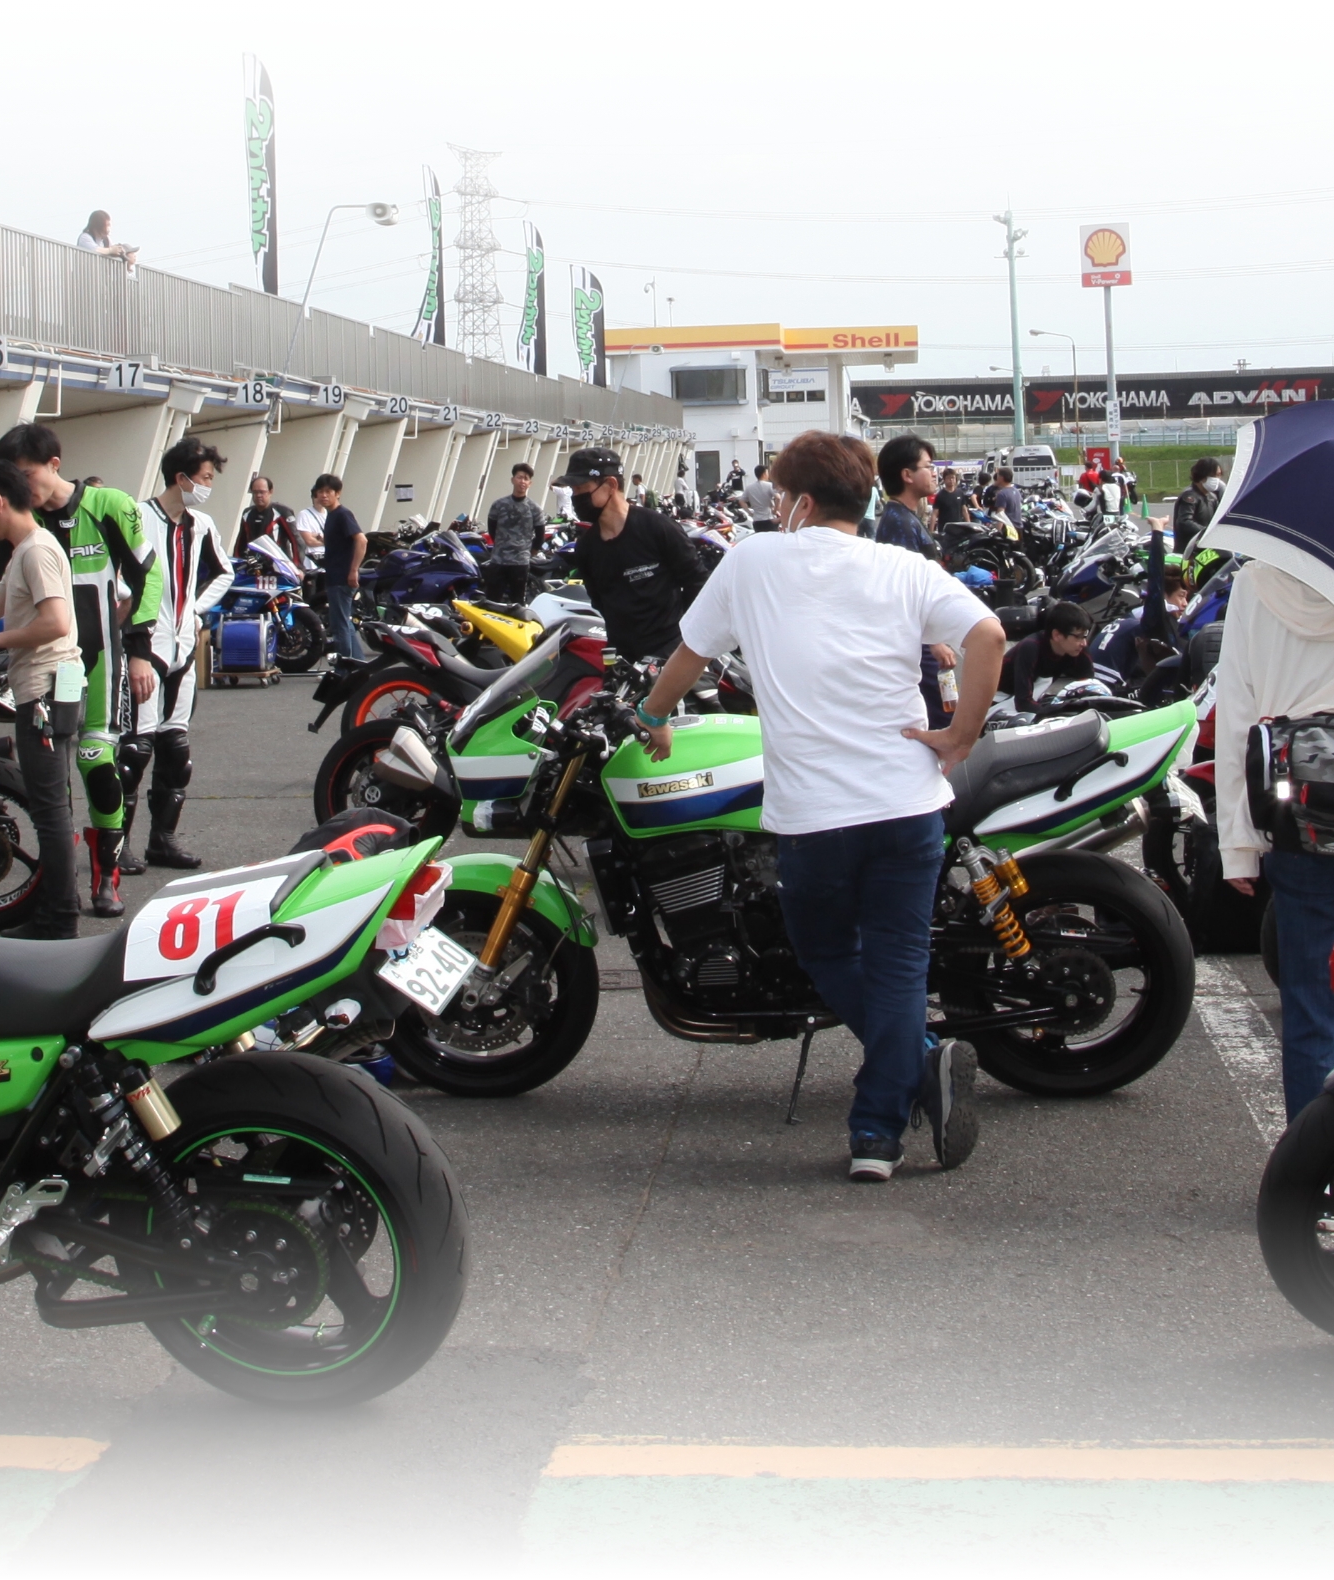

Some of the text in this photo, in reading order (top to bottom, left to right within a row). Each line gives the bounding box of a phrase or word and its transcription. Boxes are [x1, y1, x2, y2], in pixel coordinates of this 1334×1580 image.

[833, 332, 899, 348] Shell
[115, 362, 141, 388] 17
[771, 377, 815, 385] TSUKUBA
[242, 382, 265, 403] 18
[323, 385, 343, 404] 19
[1188, 387, 1306, 406] ADVAN
[390, 396, 408, 414] 20
[911, 393, 1015, 412] YOKOHAMA
[443, 406, 459, 421] 21
[486, 413, 501, 427] 22
[525, 420, 539, 433] 23
[555, 425, 568, 438] 24
[602, 425, 614, 436] 26
[652, 427, 662, 438] 29
[581, 430, 594, 441] 25
[621, 429, 632, 440] 27
[638, 433, 649, 443] 28
[69, 541, 107, 558] RIK
[257, 575, 278, 590] 113
[637, 771, 715, 798] Kawasaki
[158, 889, 247, 962] 81
[406, 940, 470, 1006] 92-40
